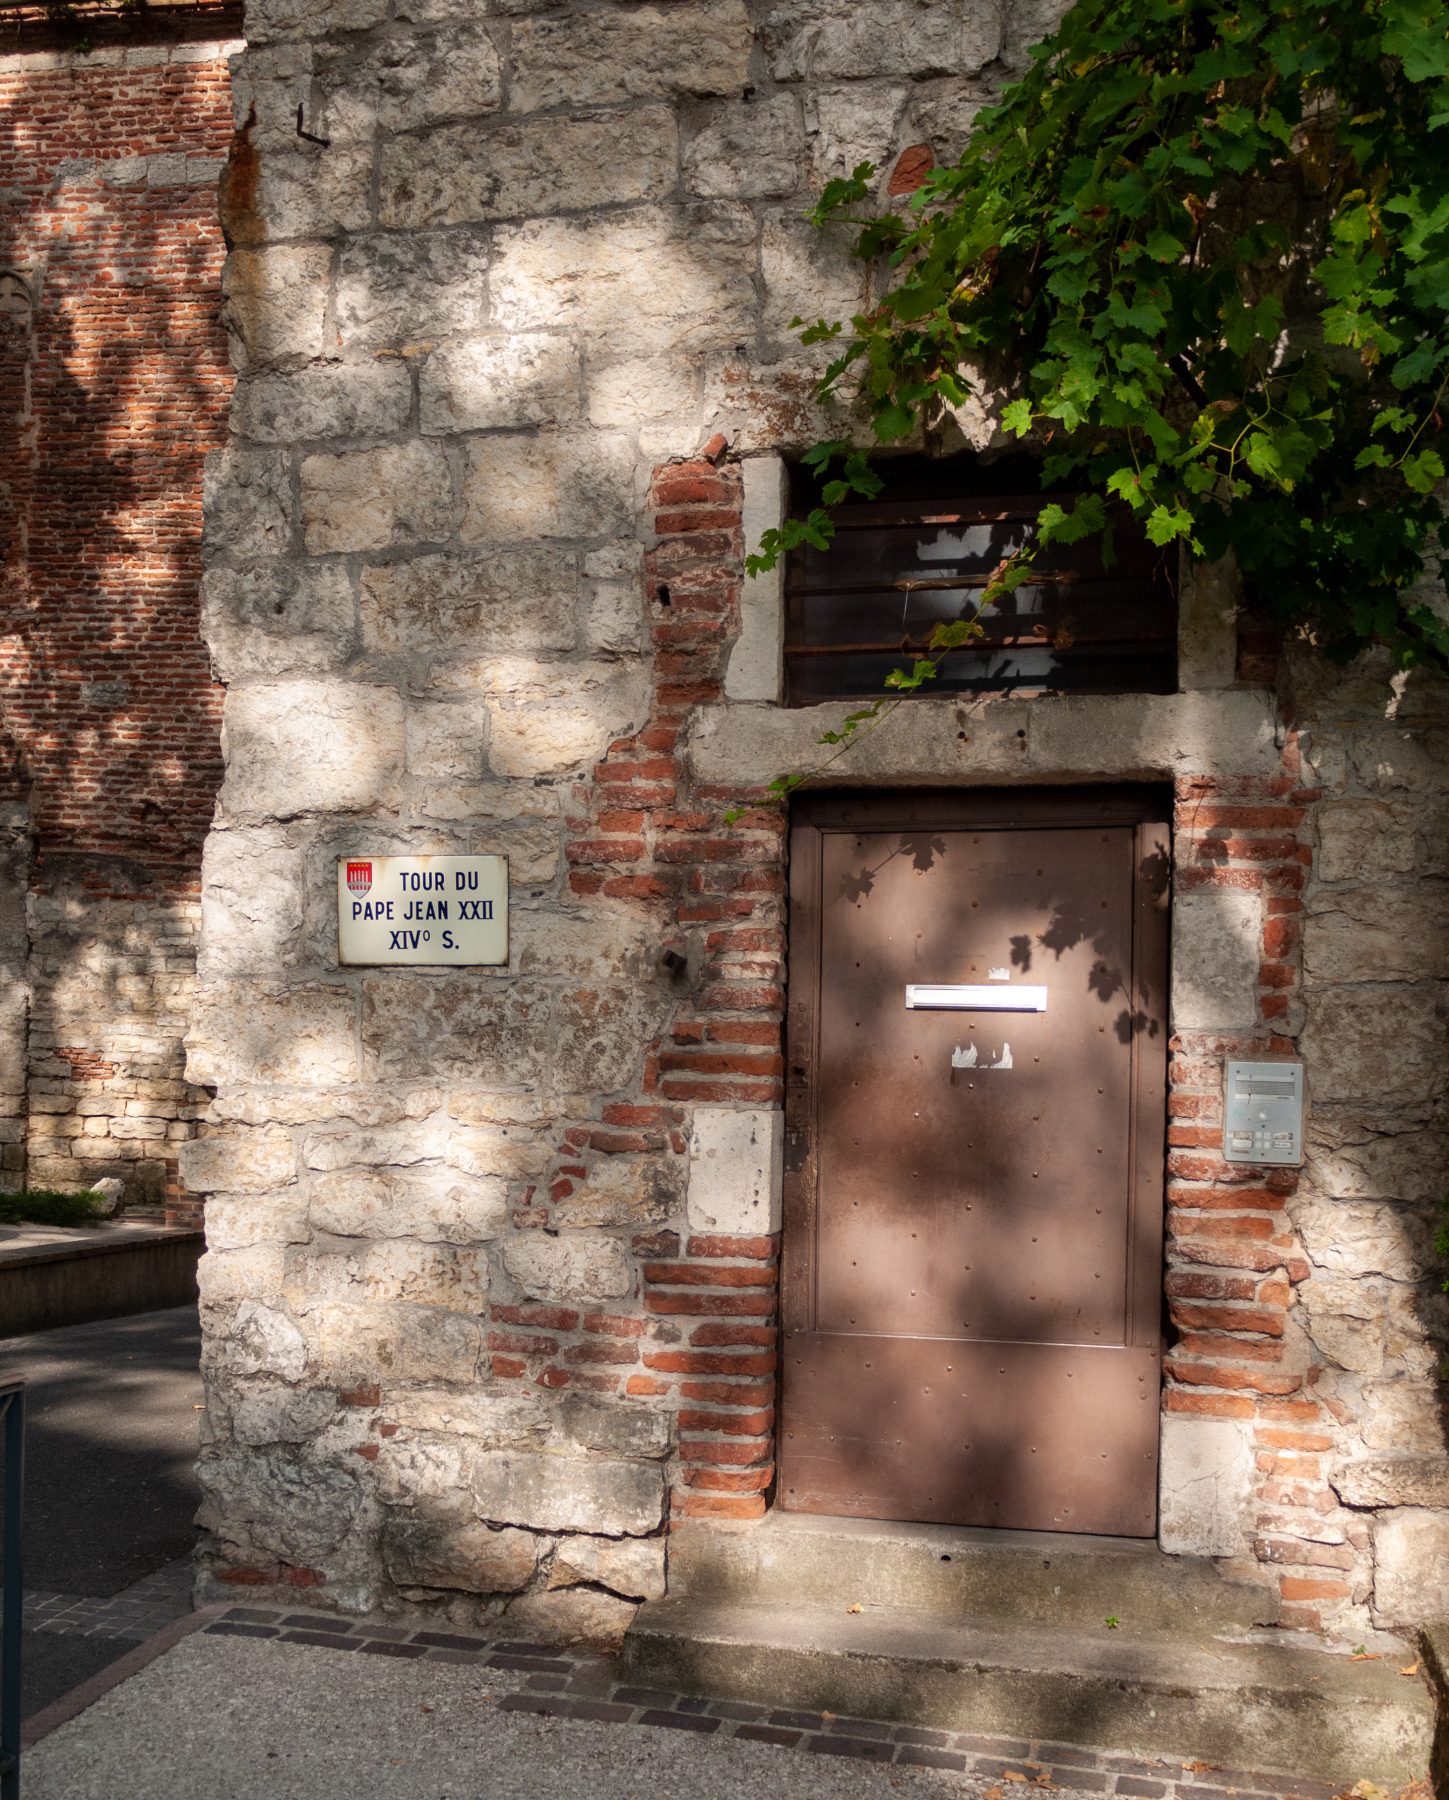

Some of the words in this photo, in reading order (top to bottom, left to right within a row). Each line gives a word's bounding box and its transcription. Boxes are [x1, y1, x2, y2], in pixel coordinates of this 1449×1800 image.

[400, 872, 445, 891] TOUR
[456, 871, 479, 891] DU
[352, 901, 394, 921] PAPE
[403, 901, 448, 920] JEAN
[458, 900, 494, 920] XXII
[442, 930, 460, 949] S.
